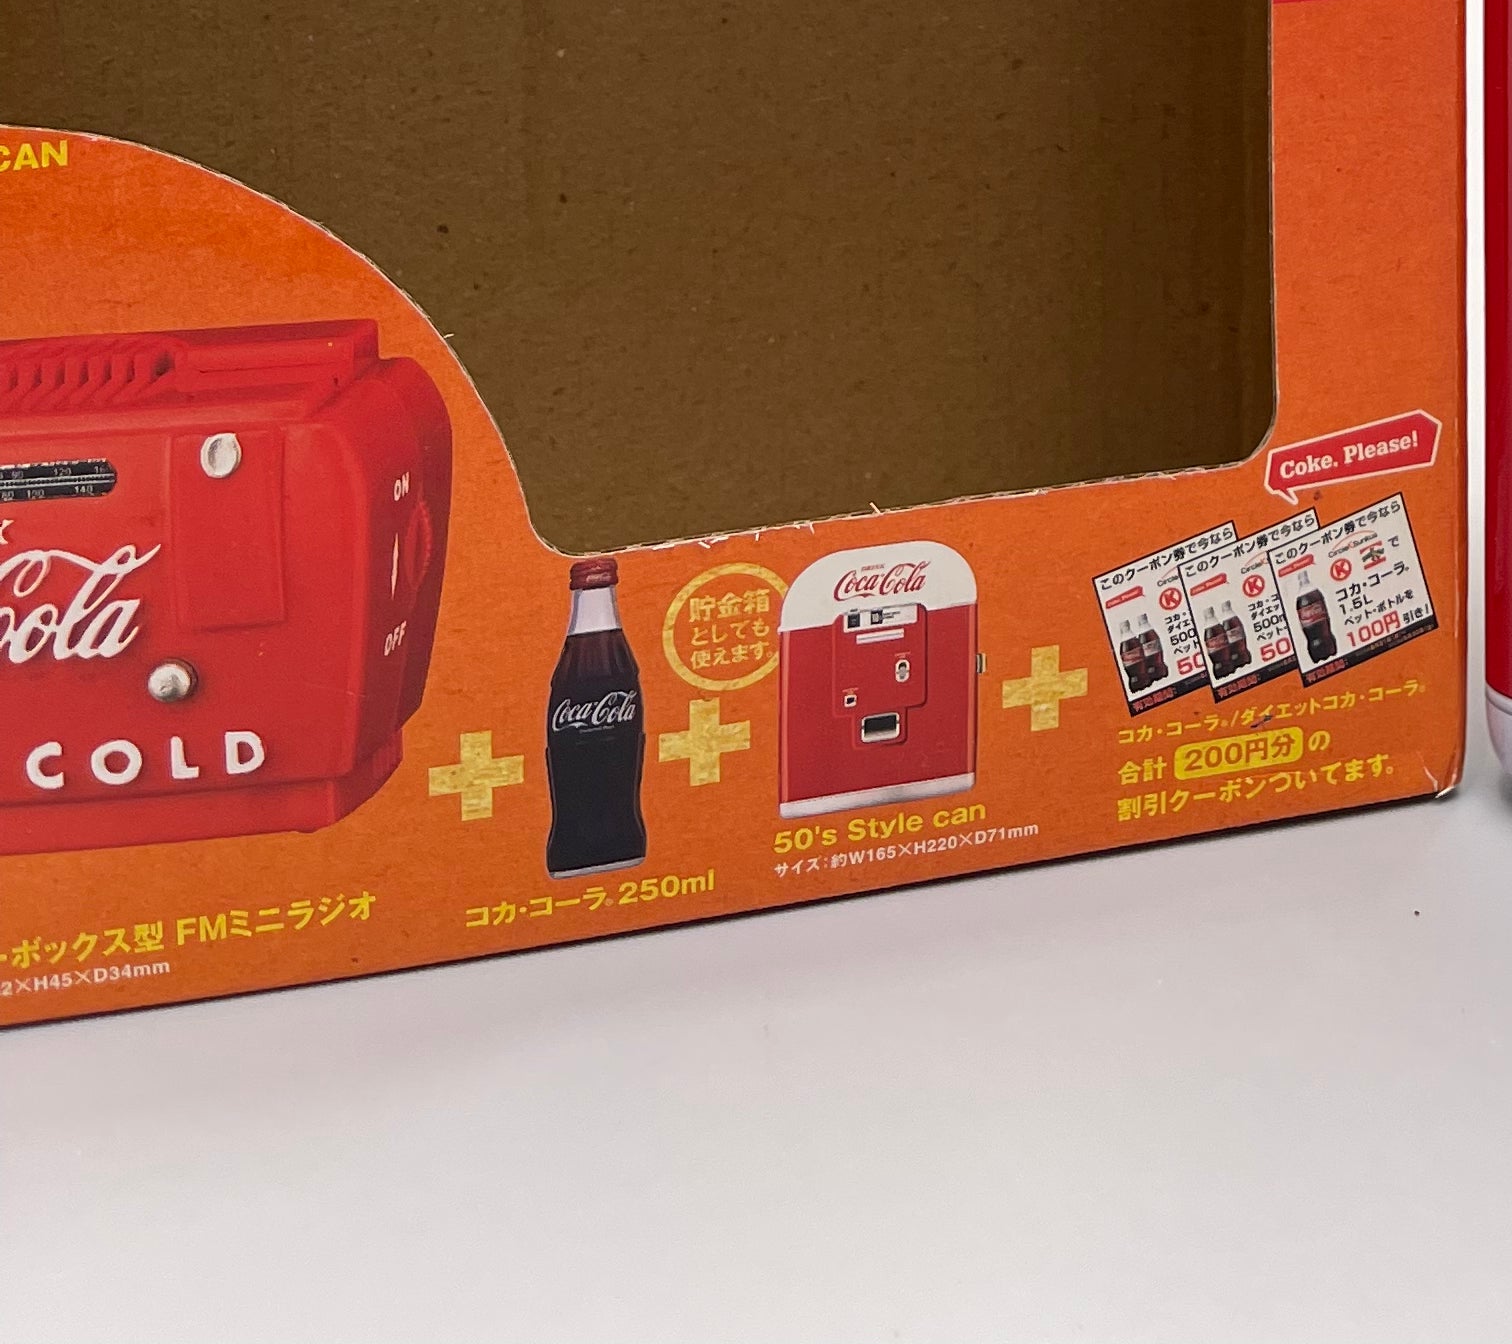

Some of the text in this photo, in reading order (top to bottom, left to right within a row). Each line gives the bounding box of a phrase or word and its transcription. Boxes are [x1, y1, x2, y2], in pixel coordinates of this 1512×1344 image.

[1342, 429, 1419, 465] Please!
[394, 471, 410, 502] ON
[1185, 513, 1315, 578] このクーポン券で今なら
[1274, 500, 1401, 565] このクーポン券で今なら
[1099, 526, 1234, 591] このクーポン券で今なら
[833, 560, 932, 602] Coca-Cola
[1335, 560, 1406, 602] コカ・コーラ
[688, 588, 772, 624] 貯金箱
[1338, 594, 1374, 616] 1.5L
[384, 619, 407, 657] OFF
[690, 617, 771, 646] としても
[1346, 610, 1401, 647] 100円
[689, 641, 774, 670] 使えます。
[1260, 637, 1292, 663] 50
[551, 689, 638, 732] Coca-Cola
[25, 730, 266, 790] COLD
[1117, 730, 1331, 786] 合計 200円分 の
[1117, 753, 1394, 822] 割引クーポンついてます。
[773, 802, 987, 854] 50's Style can
[176, 890, 377, 946] FMミニラジオ
[465, 868, 715, 928] コカ・コーラ 250ml
